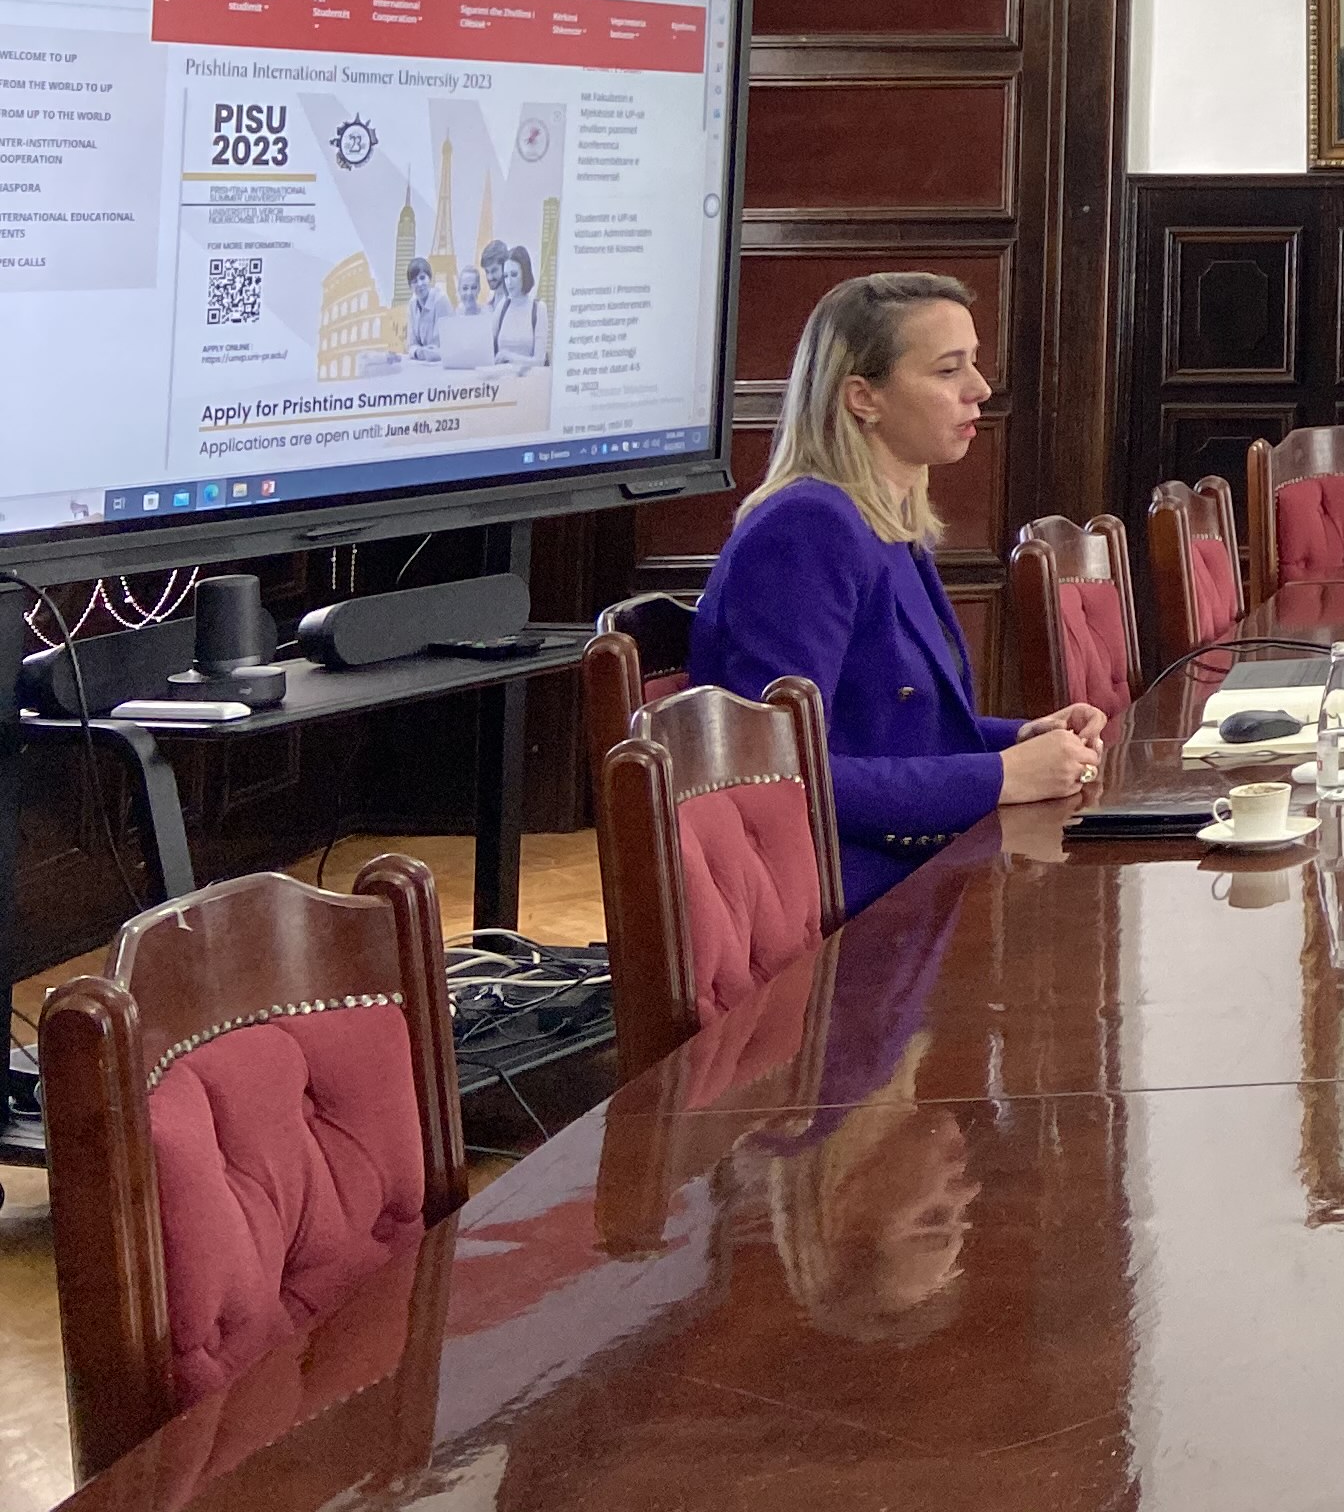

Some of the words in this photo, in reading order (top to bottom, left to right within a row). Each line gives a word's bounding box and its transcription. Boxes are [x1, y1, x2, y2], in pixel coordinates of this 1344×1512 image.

[0, 50, 47, 62] WELCOME
[49, 52, 63, 63] TO
[64, 53, 78, 64] UP
[185, 57, 248, 78] Prishtina
[252, 61, 338, 83] International
[341, 66, 394, 86] Summer
[398, 69, 460, 94] University
[462, 72, 493, 90] 2023
[28, 80, 46, 90] THE
[48, 81, 84, 92] WORLD
[85, 82, 98, 93] TO
[100, 83, 114, 93] UP
[0, 108, 25, 119] ROM
[26, 109, 40, 120] UP
[42, 110, 56, 120] TO
[57, 110, 75, 121] THE
[76, 111, 112, 122] WORLD
[213, 102, 288, 135] PISU
[0, 137, 98, 150] NTER-INSTITUTIONAL
[211, 134, 289, 167] 2023
[0, 153, 63, 165] OOPERATION
[70, 211, 136, 223] EDUCATIONAL
[17, 256, 47, 268] CALLS
[201, 402, 252, 426] Apply
[255, 398, 279, 418] for
[282, 393, 354, 417] Prishtina
[357, 390, 424, 410] Summer
[427, 382, 500, 403] University
[198, 433, 287, 459] Applications
[289, 433, 312, 447] are
[315, 429, 350, 449] open
[384, 423, 410, 438] June
[412, 420, 433, 436] 4th,
[434, 417, 461, 433] 2023
